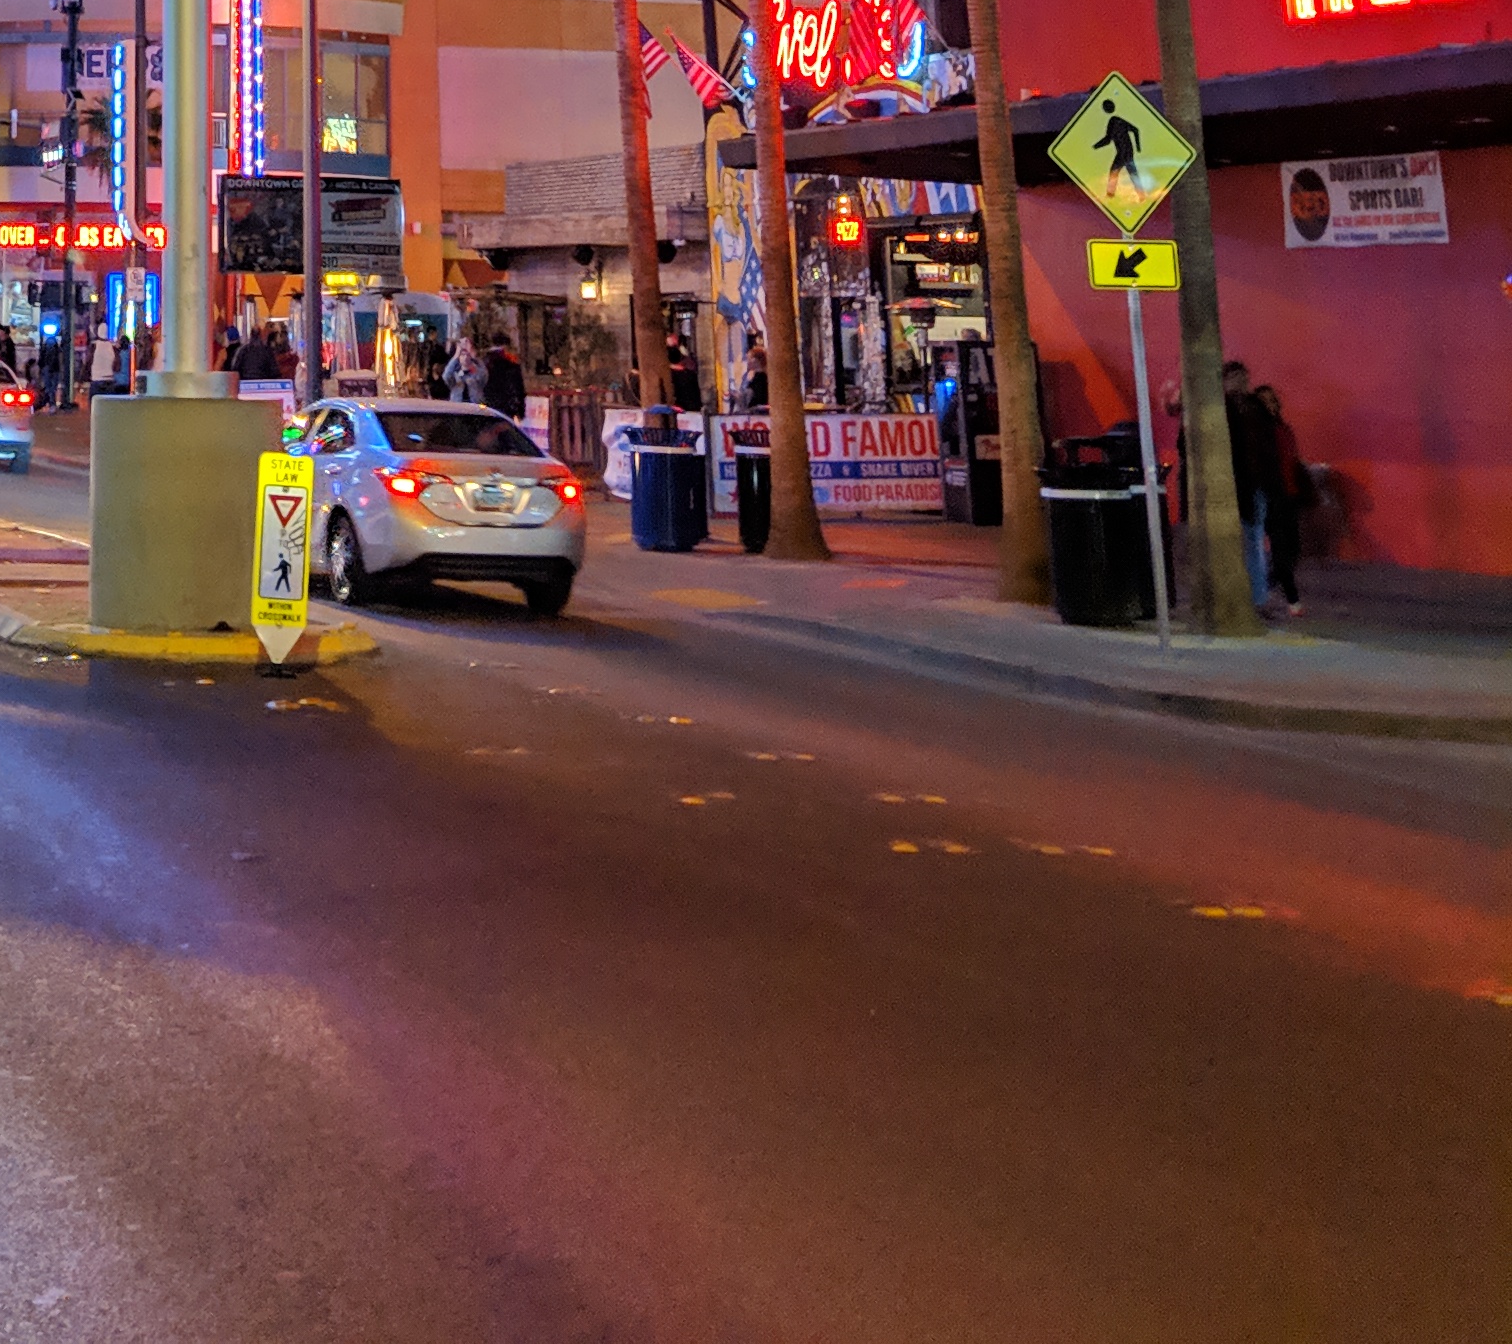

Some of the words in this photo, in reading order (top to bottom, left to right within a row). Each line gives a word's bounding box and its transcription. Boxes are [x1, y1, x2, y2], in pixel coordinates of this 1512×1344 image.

[226, 178, 291, 189] DOWNTOWN
[1348, 188, 1393, 212] SPORTS
[0, 225, 35, 247] OVER
[271, 459, 305, 471] STATE
[860, 463, 898, 477] SNAKE
[900, 462, 935, 477] RIVER
[276, 472, 299, 483] LAW
[834, 484, 872, 503] FOOD
[257, 611, 301, 623] CROSSWALK
